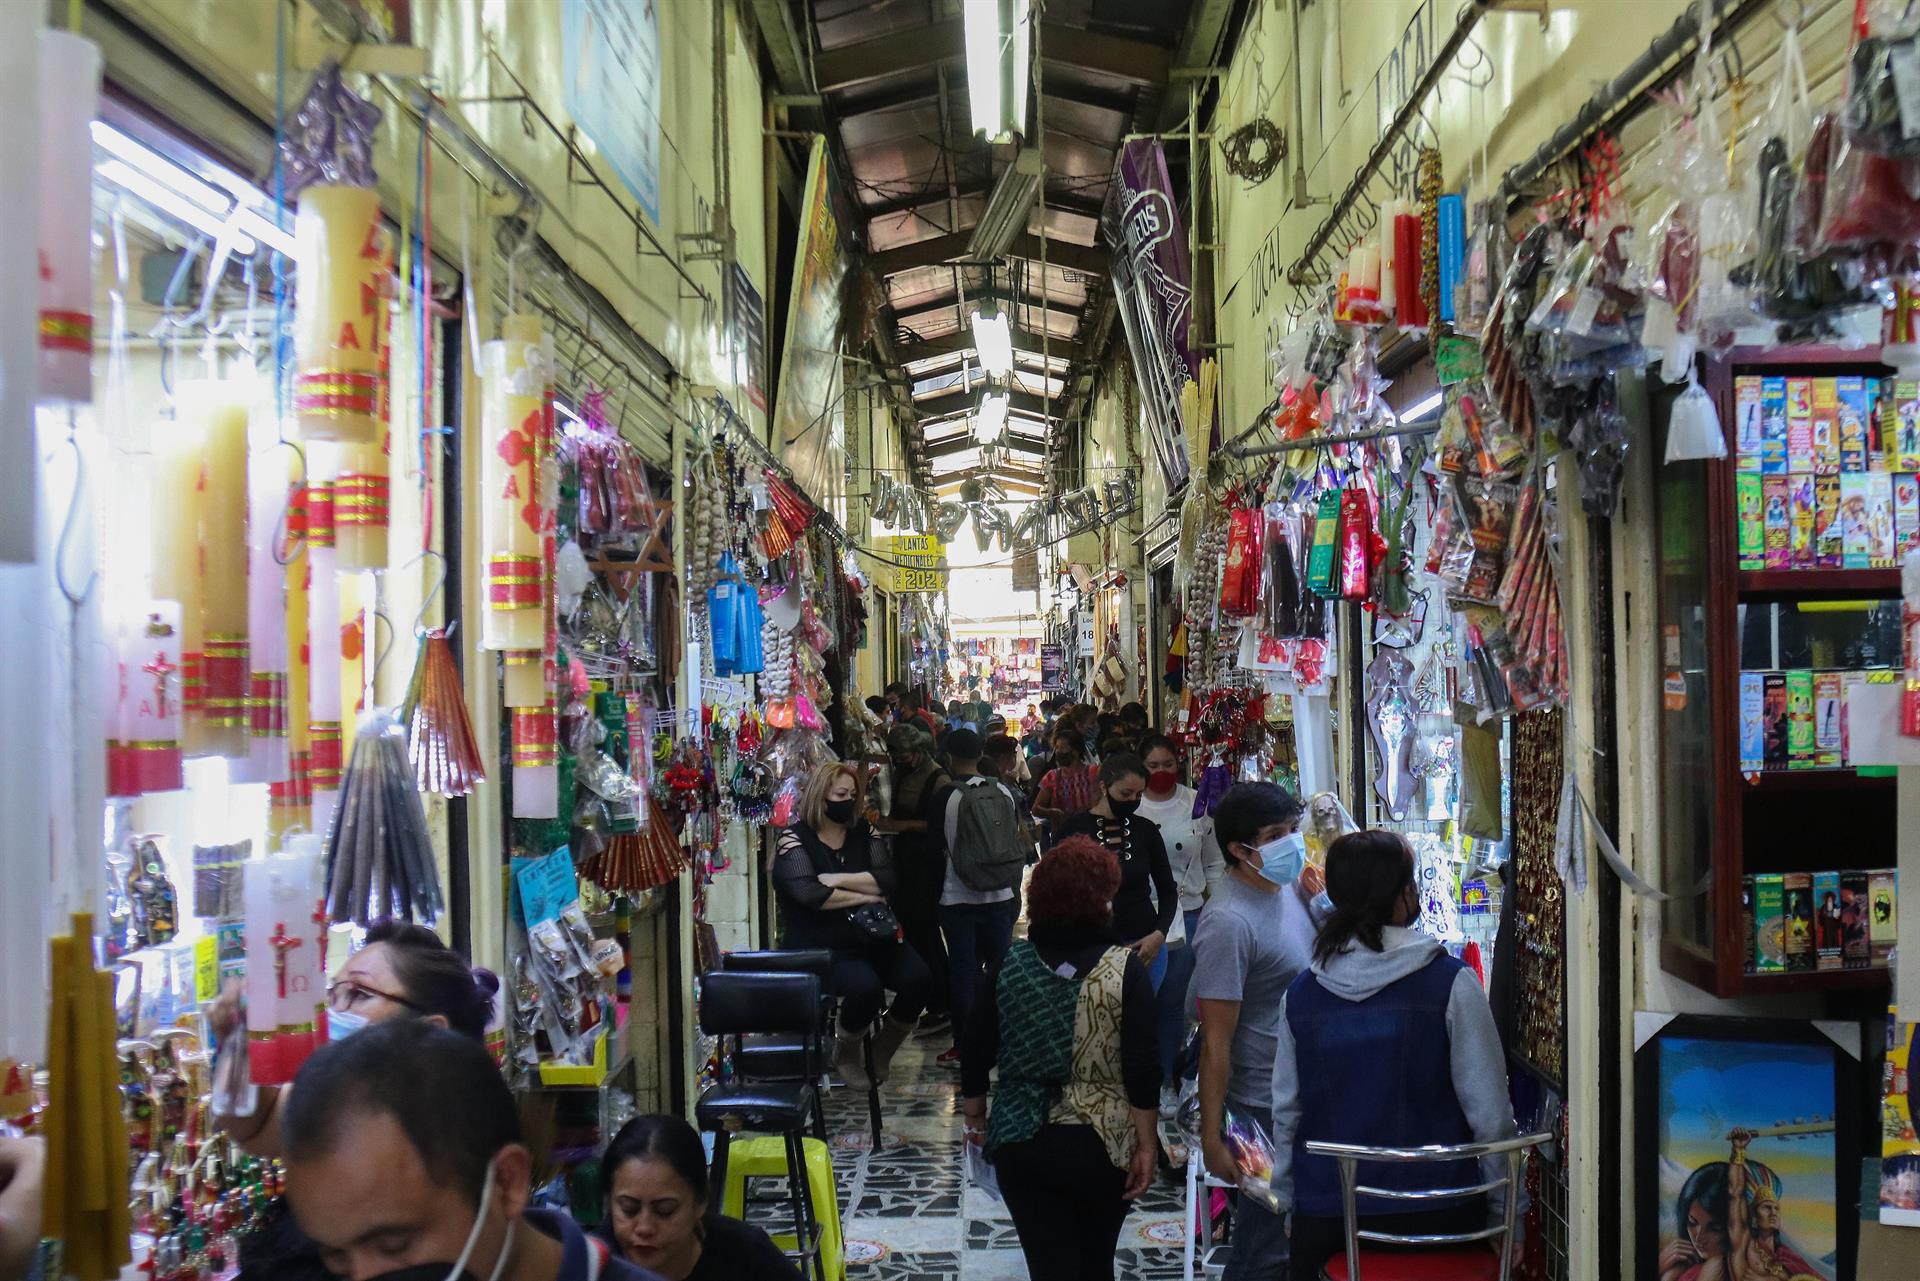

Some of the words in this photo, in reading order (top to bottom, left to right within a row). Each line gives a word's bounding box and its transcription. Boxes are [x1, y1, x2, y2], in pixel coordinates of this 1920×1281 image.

[1251, 226, 1283, 318] LOCAL
[502, 474, 520, 500] A
[895, 553, 934, 568] MEDICINALES
[905, 570, 937, 589] 202
